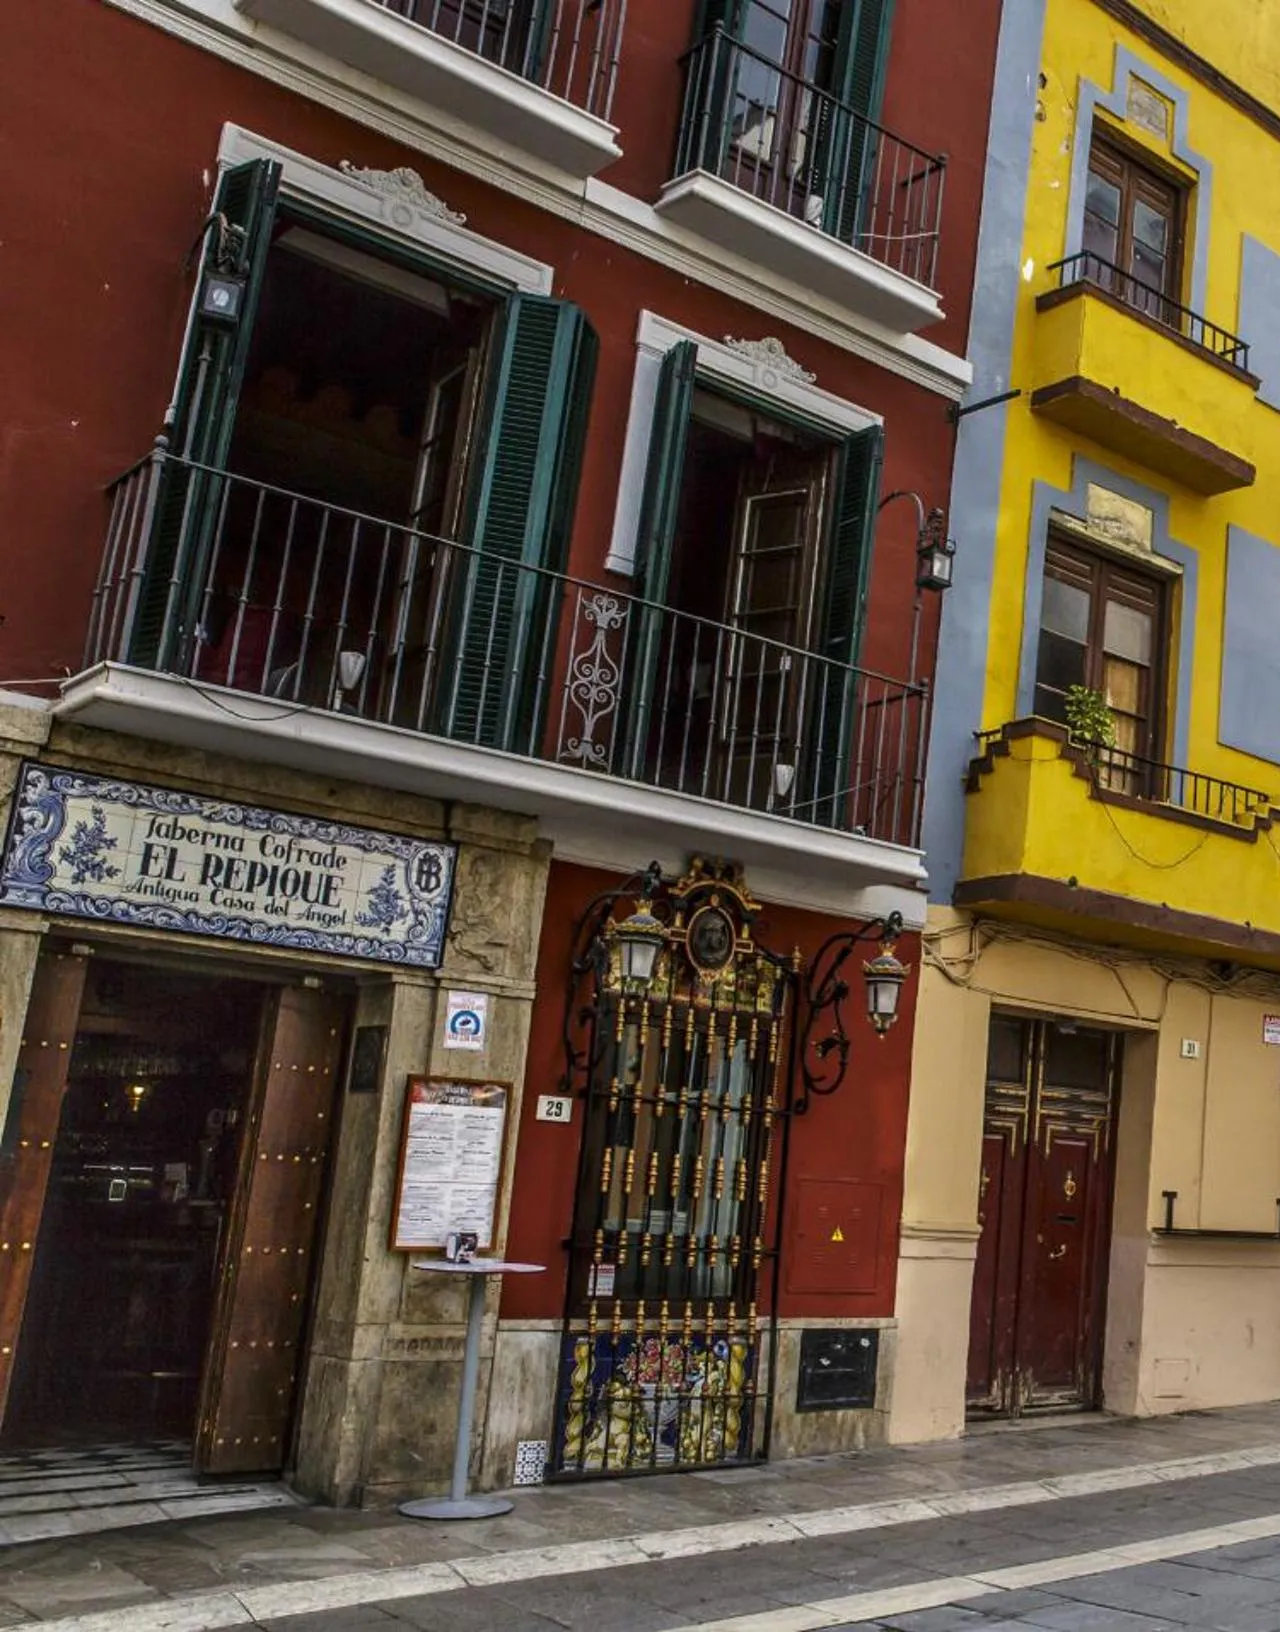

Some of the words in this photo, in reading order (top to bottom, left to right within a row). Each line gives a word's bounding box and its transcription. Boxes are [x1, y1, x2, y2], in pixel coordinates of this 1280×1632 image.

[145, 812, 245, 852] Taberna
[258, 834, 348, 870] Cofrade
[139, 841, 186, 883] EL
[198, 852, 345, 908] REPIQUE
[209, 888, 256, 912] Casa
[263, 900, 289, 917] del
[545, 1100, 563, 1118] 29
